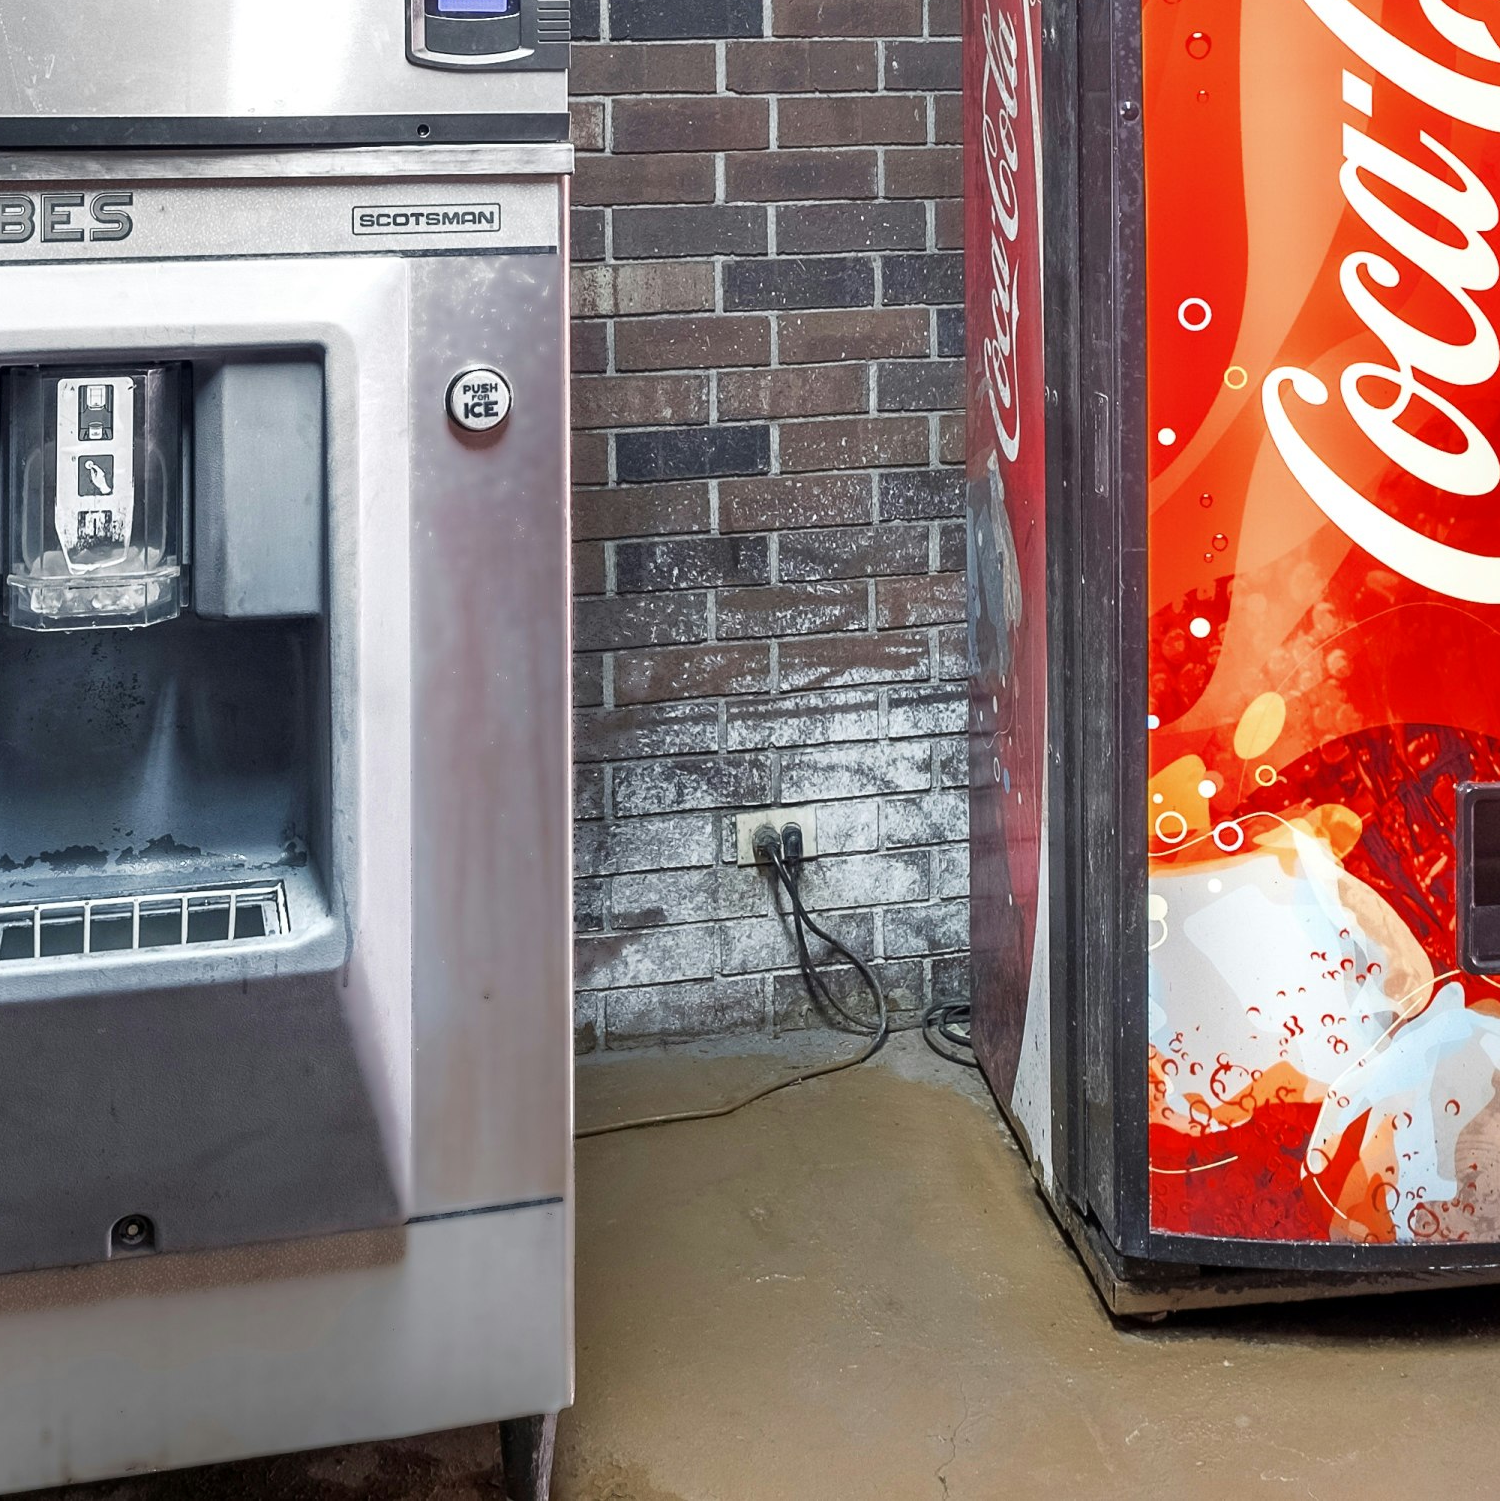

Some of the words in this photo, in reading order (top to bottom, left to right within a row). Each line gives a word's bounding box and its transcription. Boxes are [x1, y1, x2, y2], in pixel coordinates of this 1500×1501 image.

[359, 210, 495, 228] SCOTSMAN
[463, 383, 498, 395] PUSH
[472, 393, 490, 401] FOR
[464, 400, 499, 420] ICE
